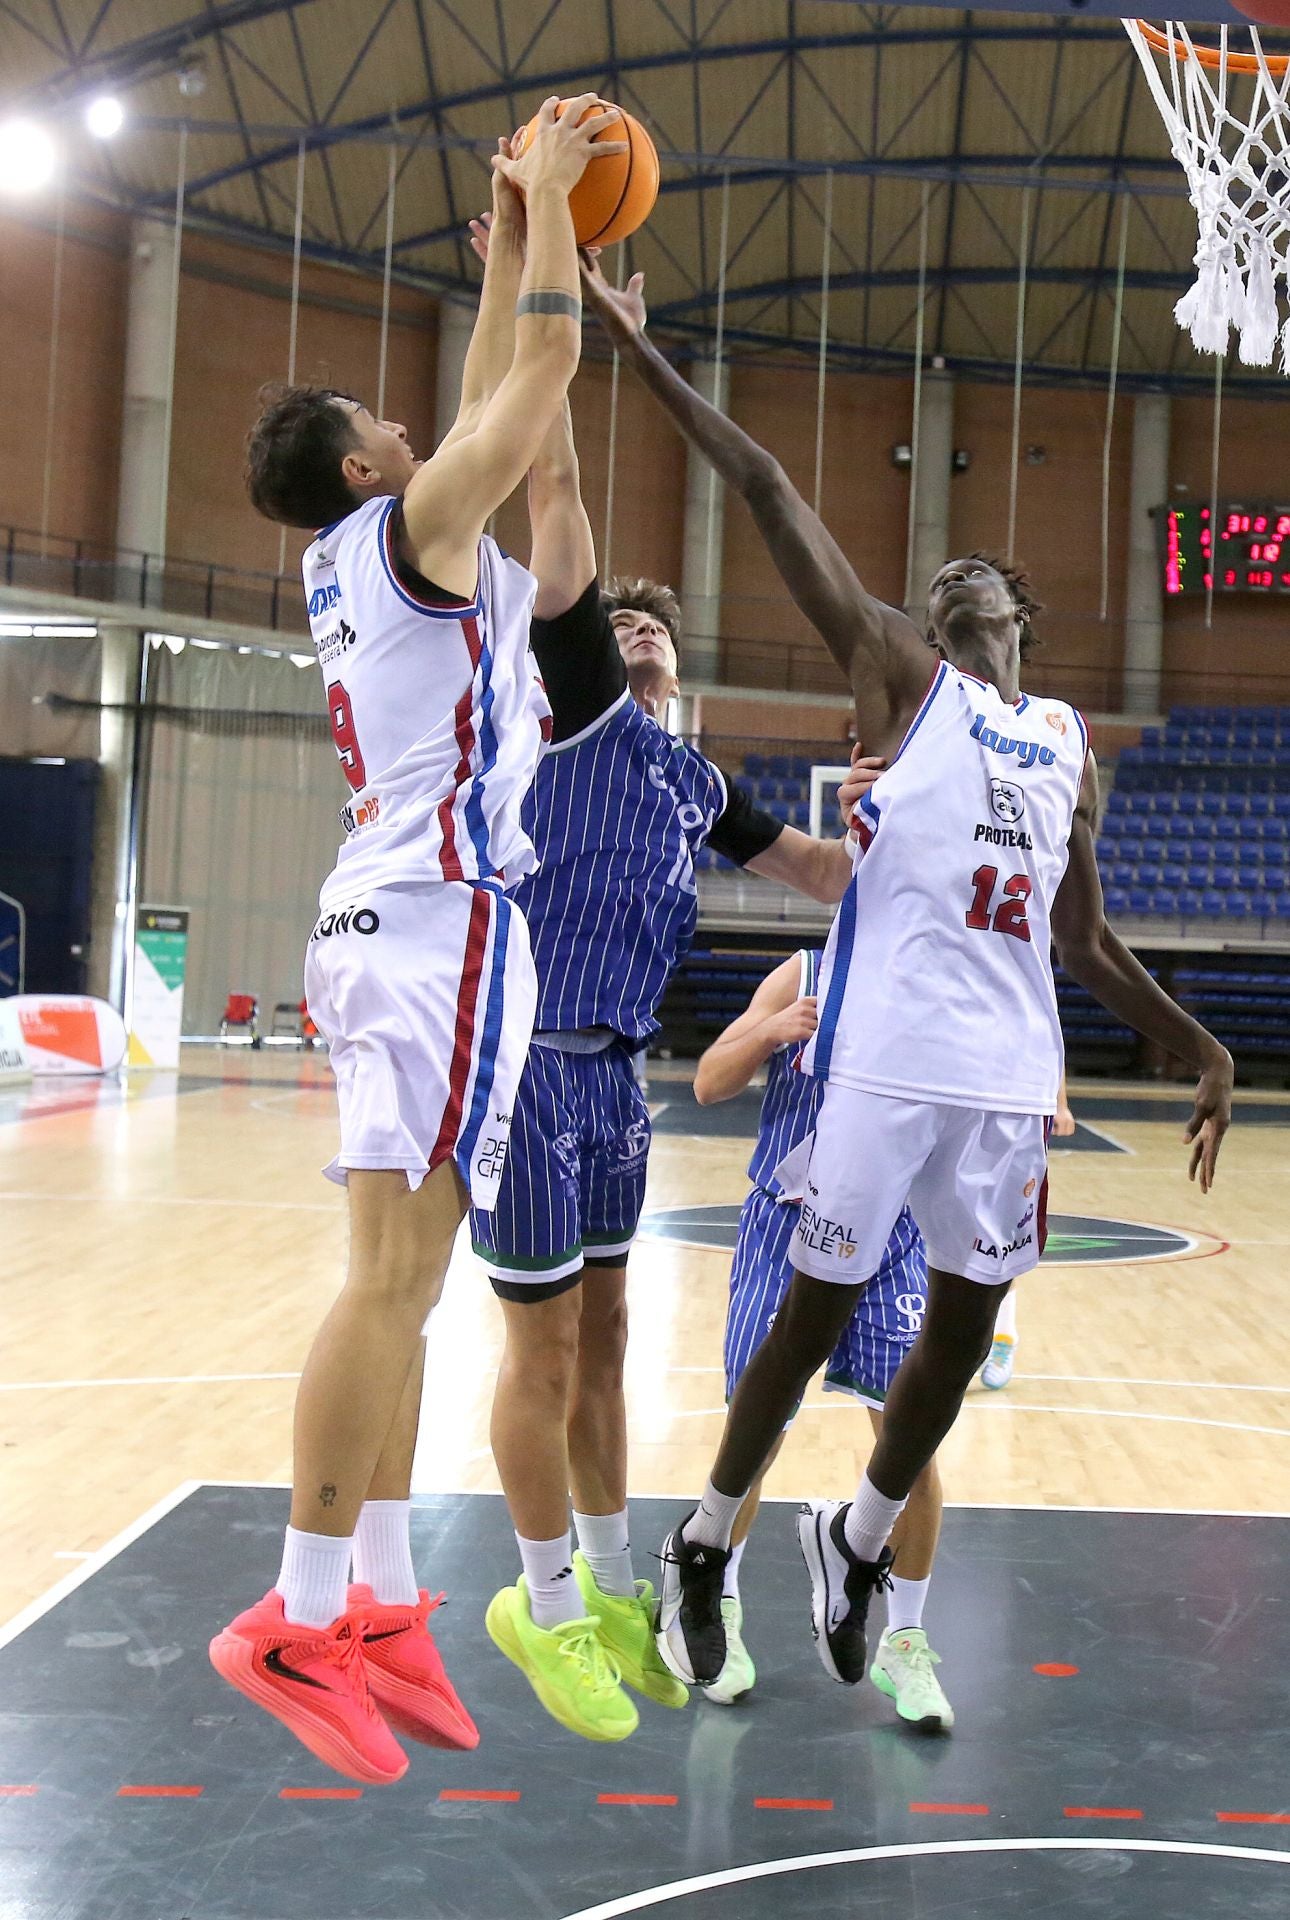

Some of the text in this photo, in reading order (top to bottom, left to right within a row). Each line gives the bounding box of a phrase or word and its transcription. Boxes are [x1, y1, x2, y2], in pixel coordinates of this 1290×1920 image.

[327, 680, 367, 793] 9
[965, 864, 1033, 943] 12
[798, 1220, 856, 1259] HILE 19
[801, 1203, 858, 1244] ENTAL
